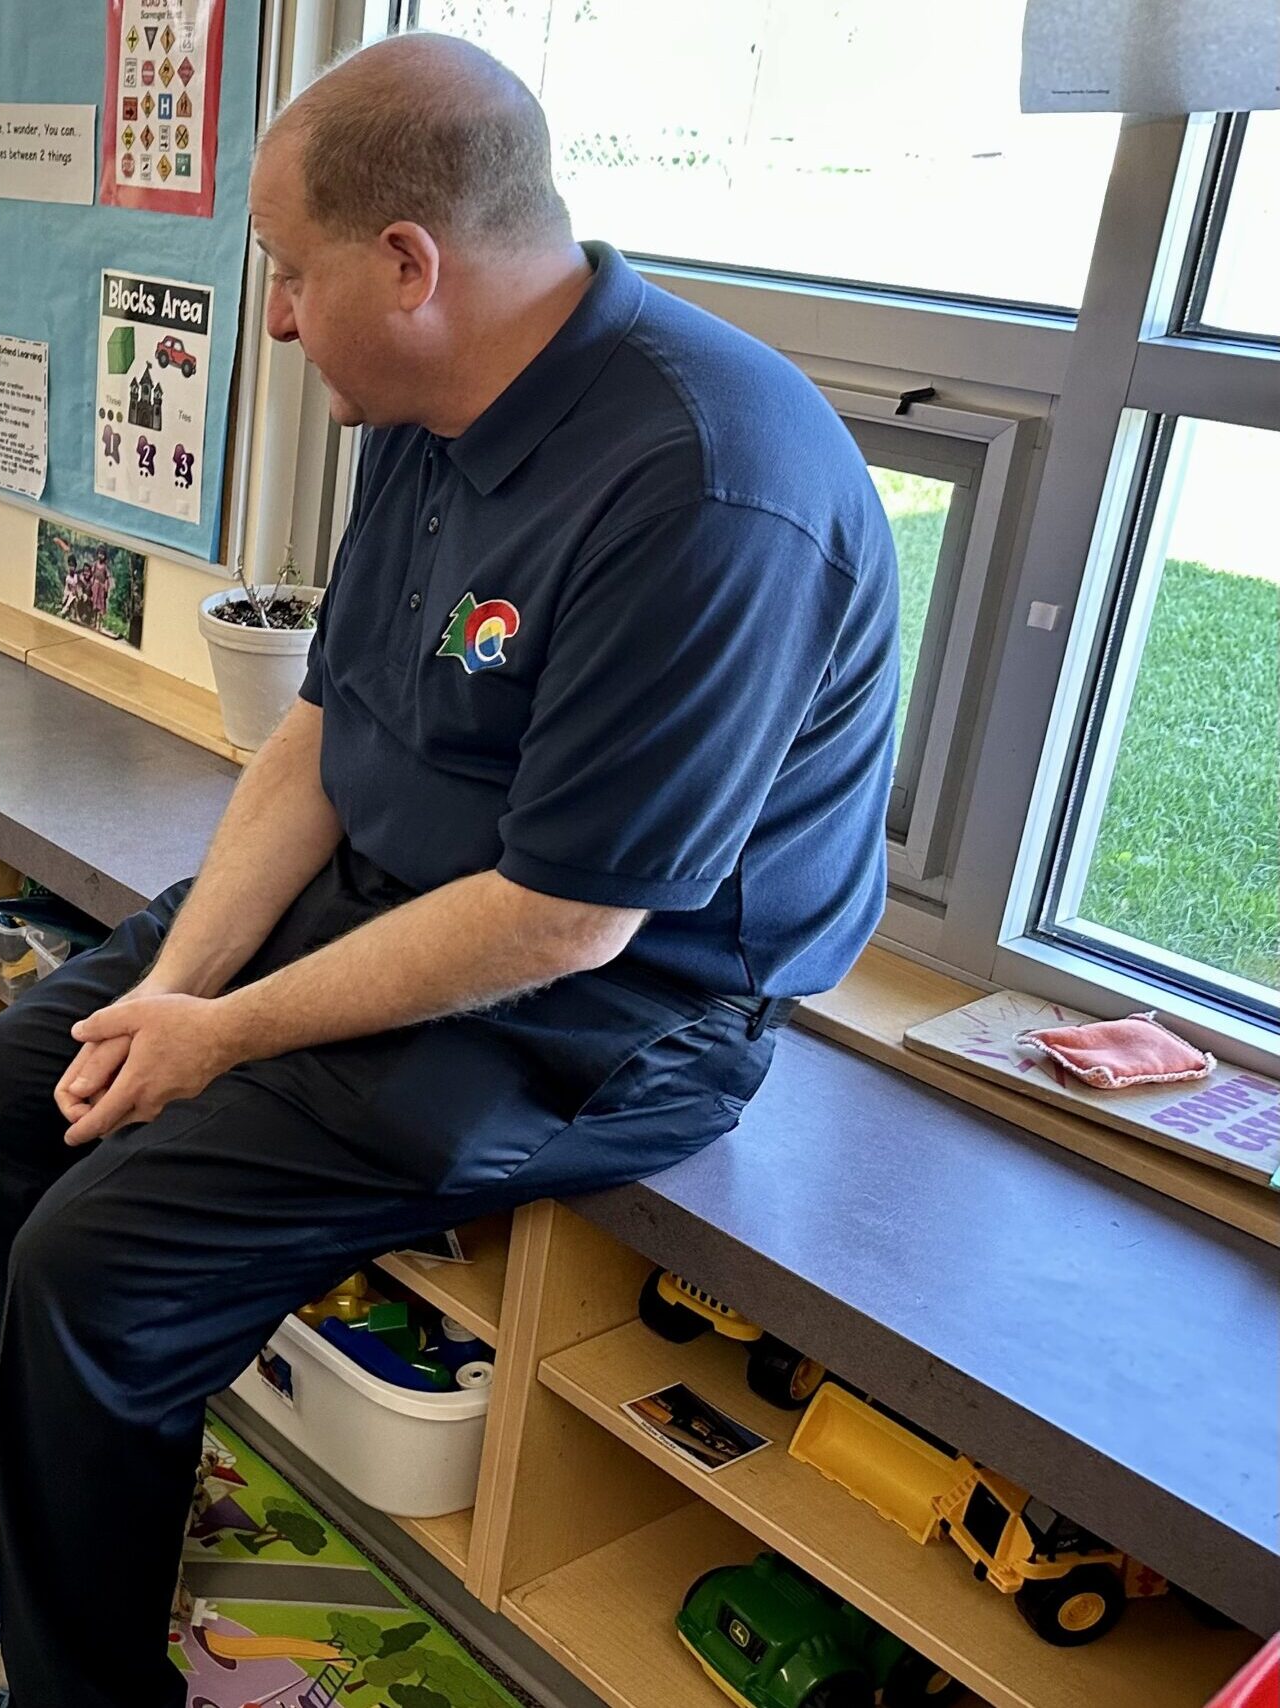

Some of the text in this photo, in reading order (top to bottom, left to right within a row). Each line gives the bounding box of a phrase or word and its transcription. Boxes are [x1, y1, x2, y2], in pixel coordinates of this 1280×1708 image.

[160, 98, 170, 116] H
[43, 123, 58, 136] You
[8, 148, 37, 162] between
[40, 149, 45, 161] 2
[47, 150, 72, 166] things
[109, 279, 203, 325] Blocks Area
[17, 348, 42, 363] Learning
[142, 445, 150, 466] 2
[180, 454, 188, 475] 3
